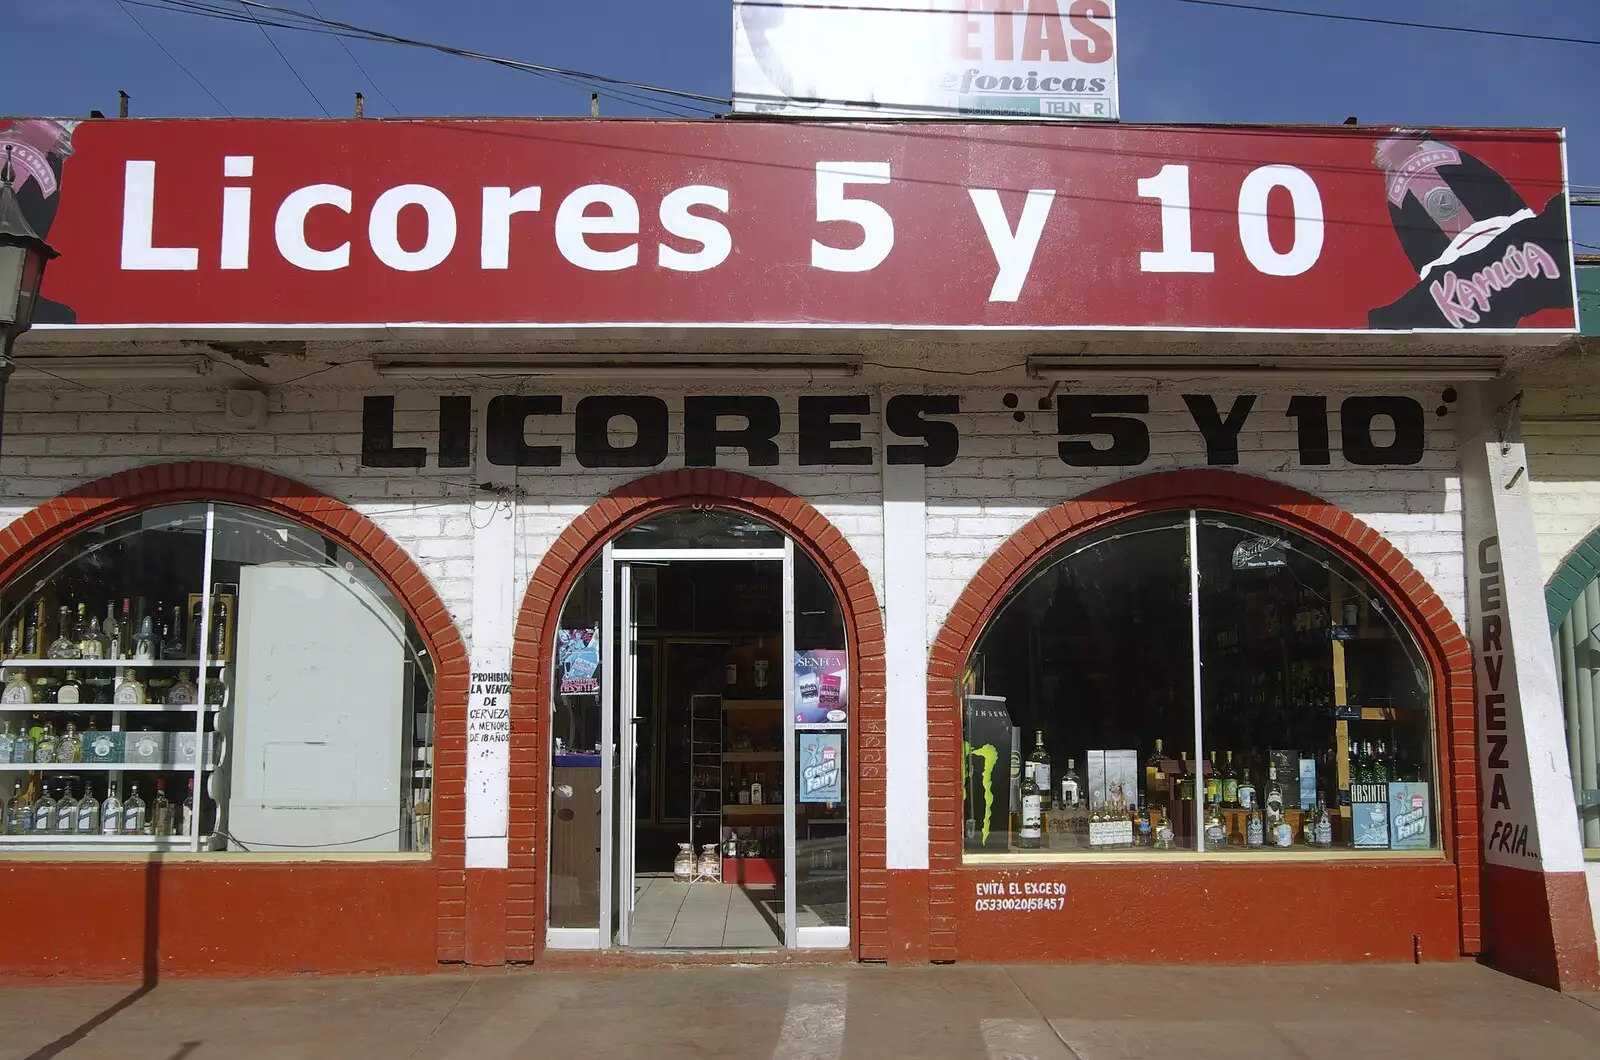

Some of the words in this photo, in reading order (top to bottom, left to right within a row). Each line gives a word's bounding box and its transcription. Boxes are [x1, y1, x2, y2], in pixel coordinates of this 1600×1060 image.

[1394, 153, 1449, 194] ORIGINAL
[120, 155, 733, 272] Licores
[811, 161, 894, 273] 5
[967, 189, 1056, 302] y
[1137, 164, 1325, 276] 10
[361, 394, 960, 468] LICORES
[1057, 394, 1150, 467] 5
[1181, 394, 1258, 466] Y
[1286, 394, 1425, 466] 10
[798, 657, 841, 667] SENECA
[1477, 535, 1510, 810] CERVEZA
[470, 684, 482, 694] LA
[485, 684, 512, 694] VENTA
[483, 697, 497, 707] DE
[470, 708, 510, 719] CERVEZA
[470, 723, 475, 731] A
[479, 721, 515, 732] MENORES
[470, 733, 479, 743] DE
[489, 732, 510, 742] AÑOS
[804, 760, 834, 779] Green
[806, 769, 839, 794] Fairy
[1351, 784, 1387, 802] ABSINTH
[1394, 807, 1423, 828] Green
[1397, 816, 1427, 841] Fairy
[976, 882, 1004, 895] EVITA
[1009, 882, 1022, 894] EL
[1025, 882, 1066, 895] EXCESO
